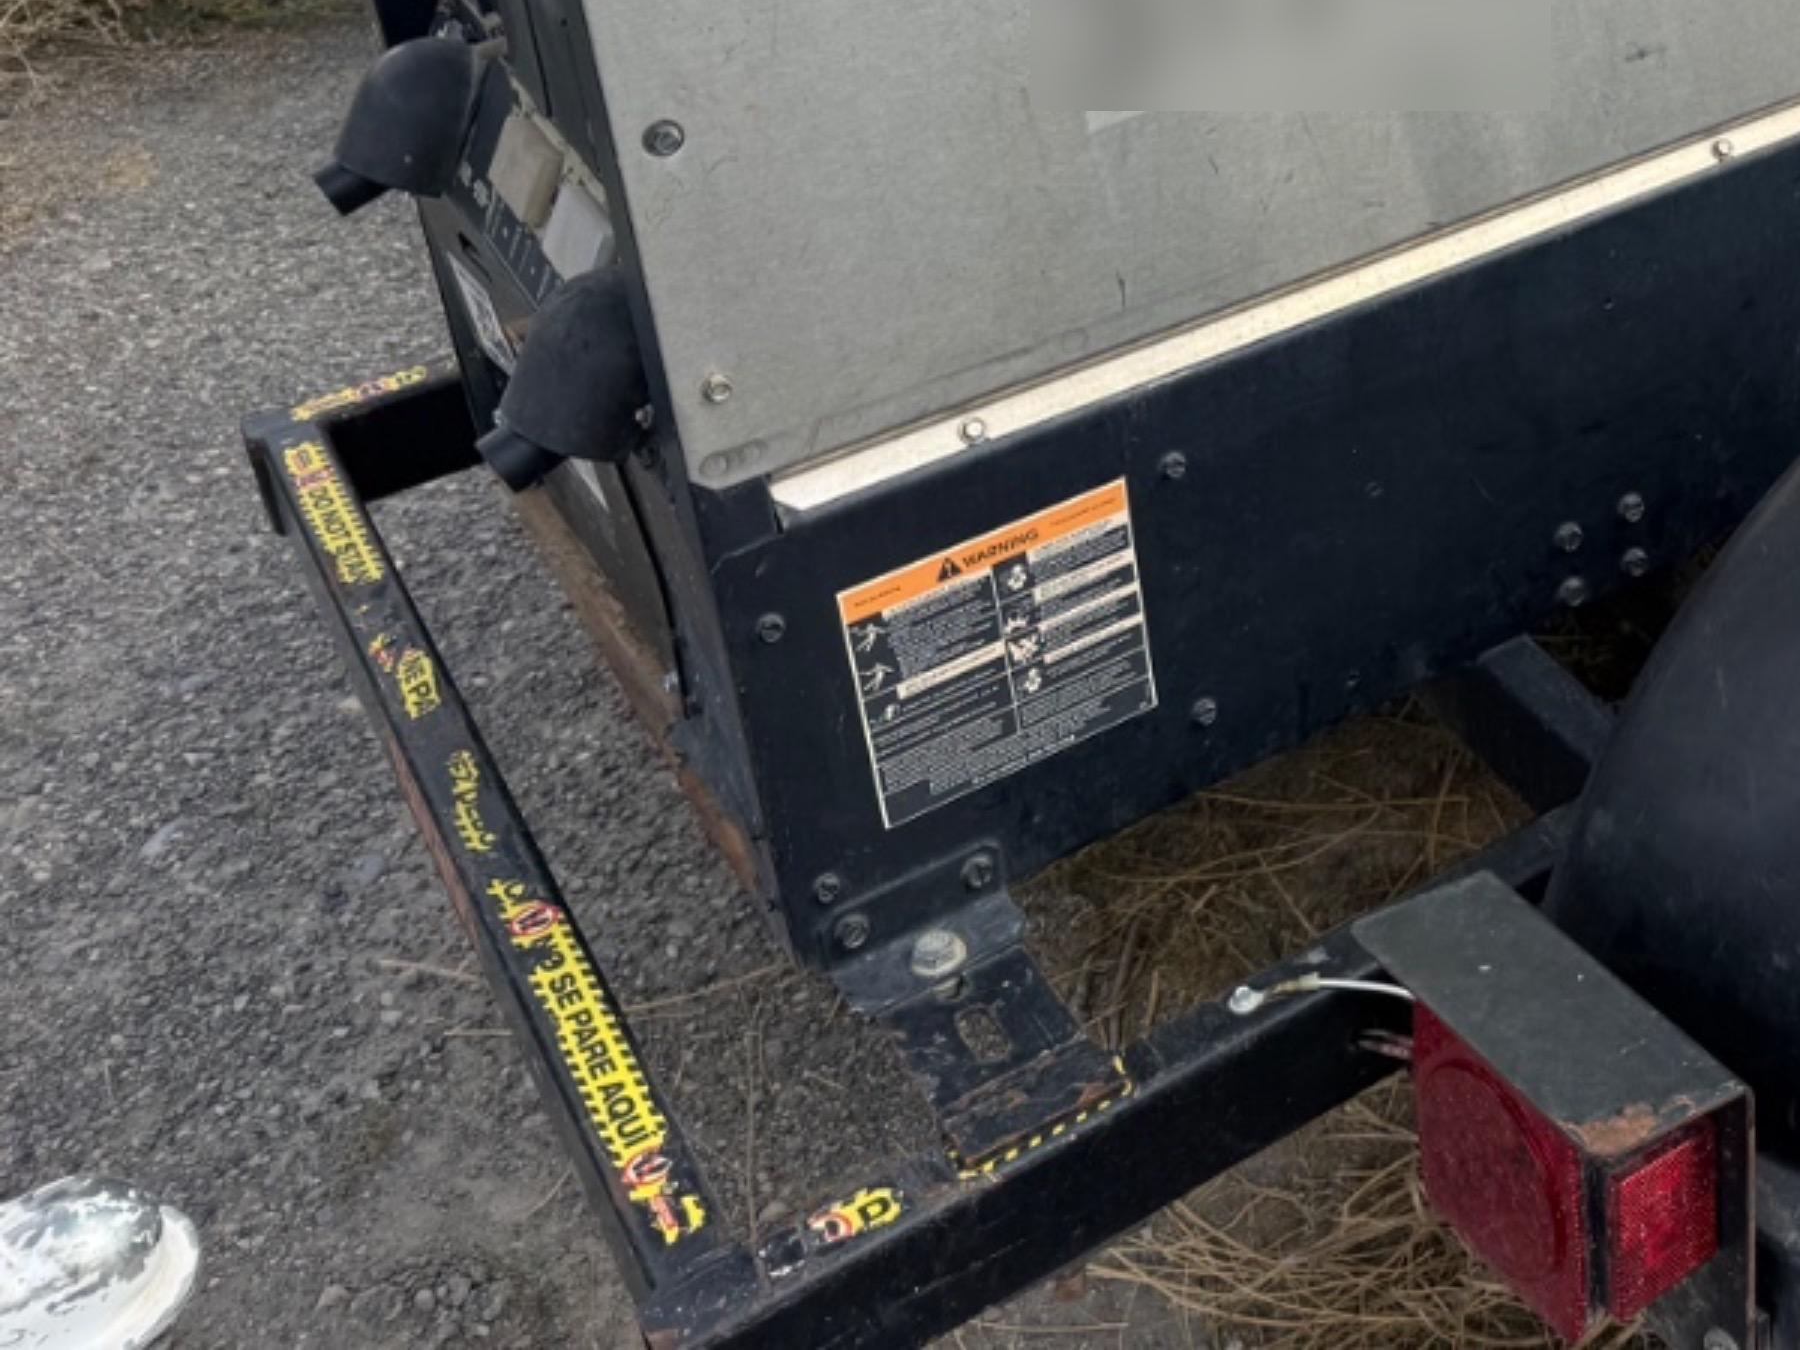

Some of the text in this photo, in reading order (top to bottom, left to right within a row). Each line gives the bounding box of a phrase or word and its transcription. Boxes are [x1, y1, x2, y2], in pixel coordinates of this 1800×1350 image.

[961, 527, 1040, 568] WARNING
[549, 971, 583, 1009] SE
[565, 1011, 617, 1079] PARE
[600, 1078, 659, 1148] AQUÍ
